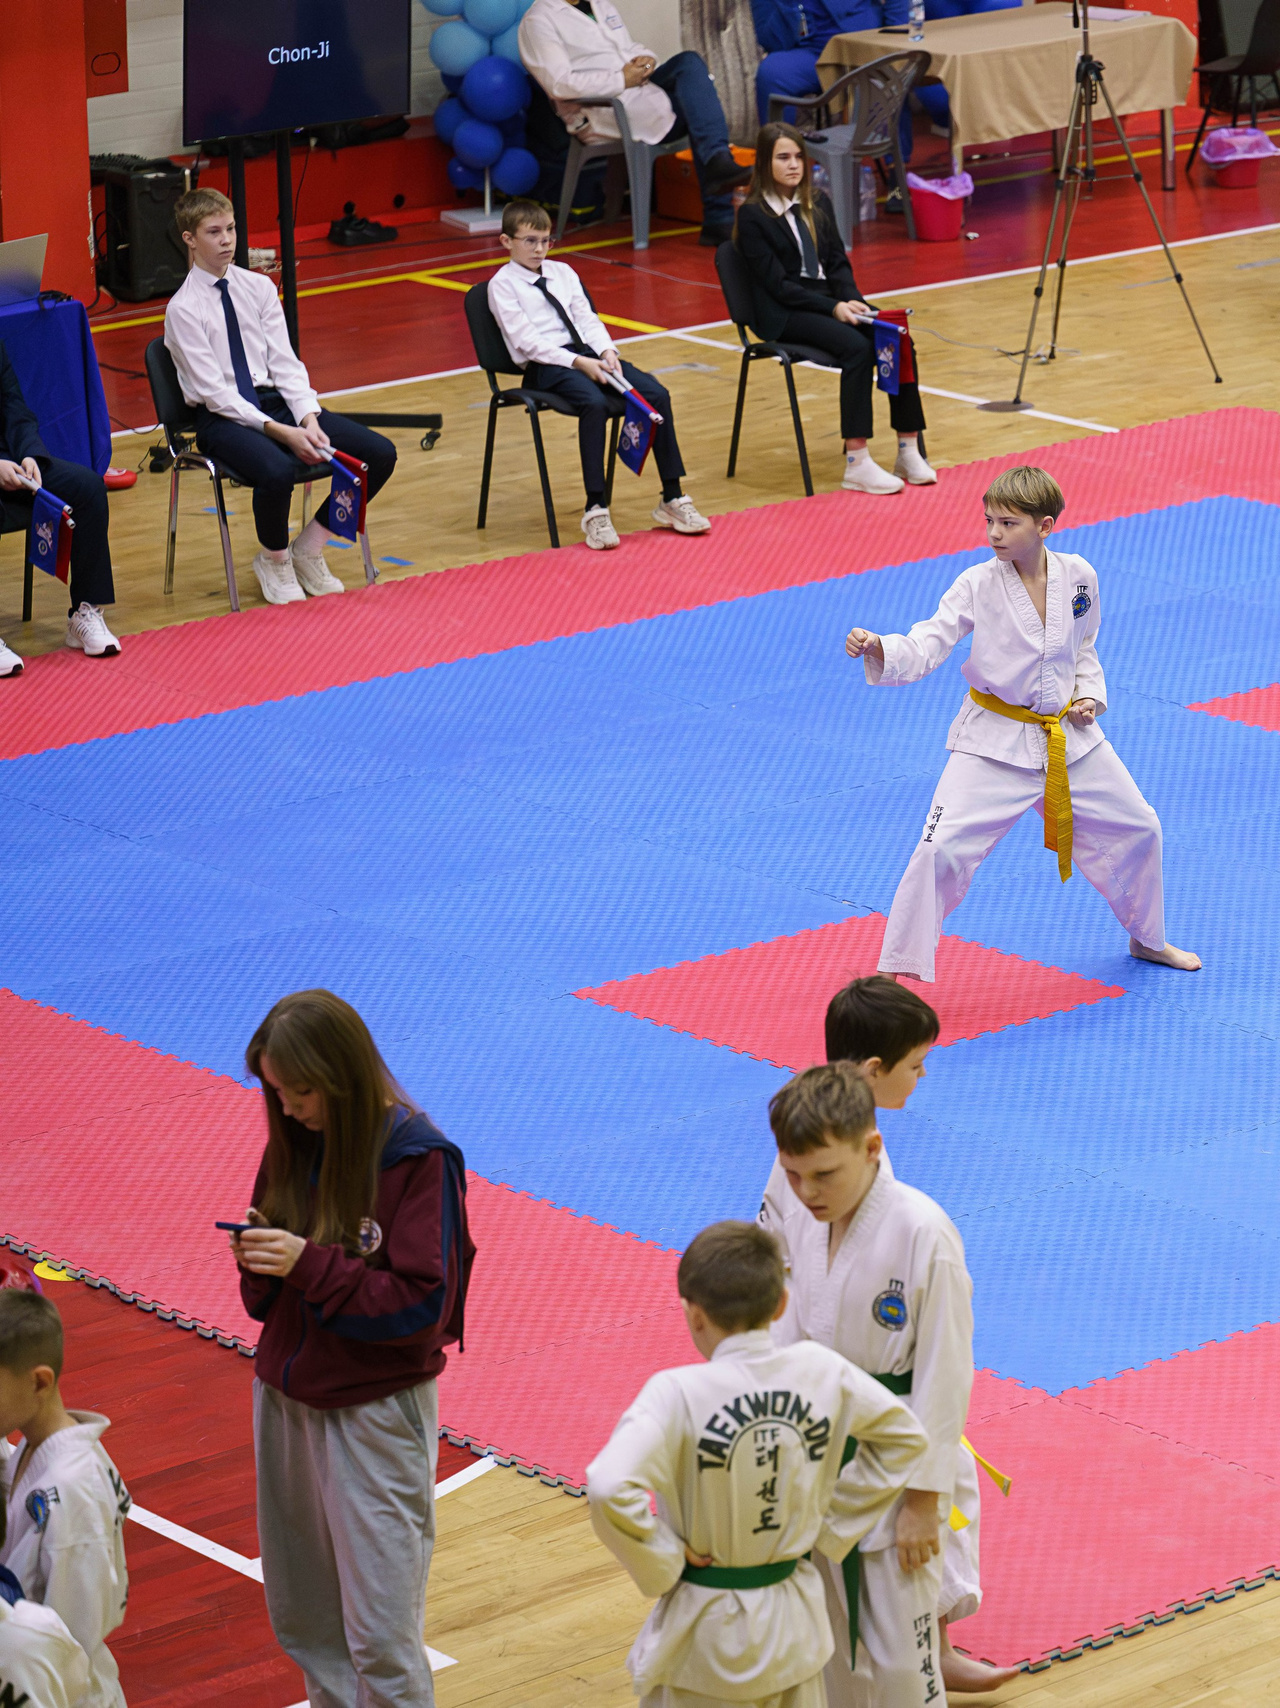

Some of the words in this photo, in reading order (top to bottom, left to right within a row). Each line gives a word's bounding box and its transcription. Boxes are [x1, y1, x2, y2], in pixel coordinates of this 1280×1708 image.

[268, 40, 330, 65] Chon-Ji
[1077, 585, 1088, 593] ITF
[754, 1427, 780, 1444] ITF
[913, 1612, 931, 1631] ITF
